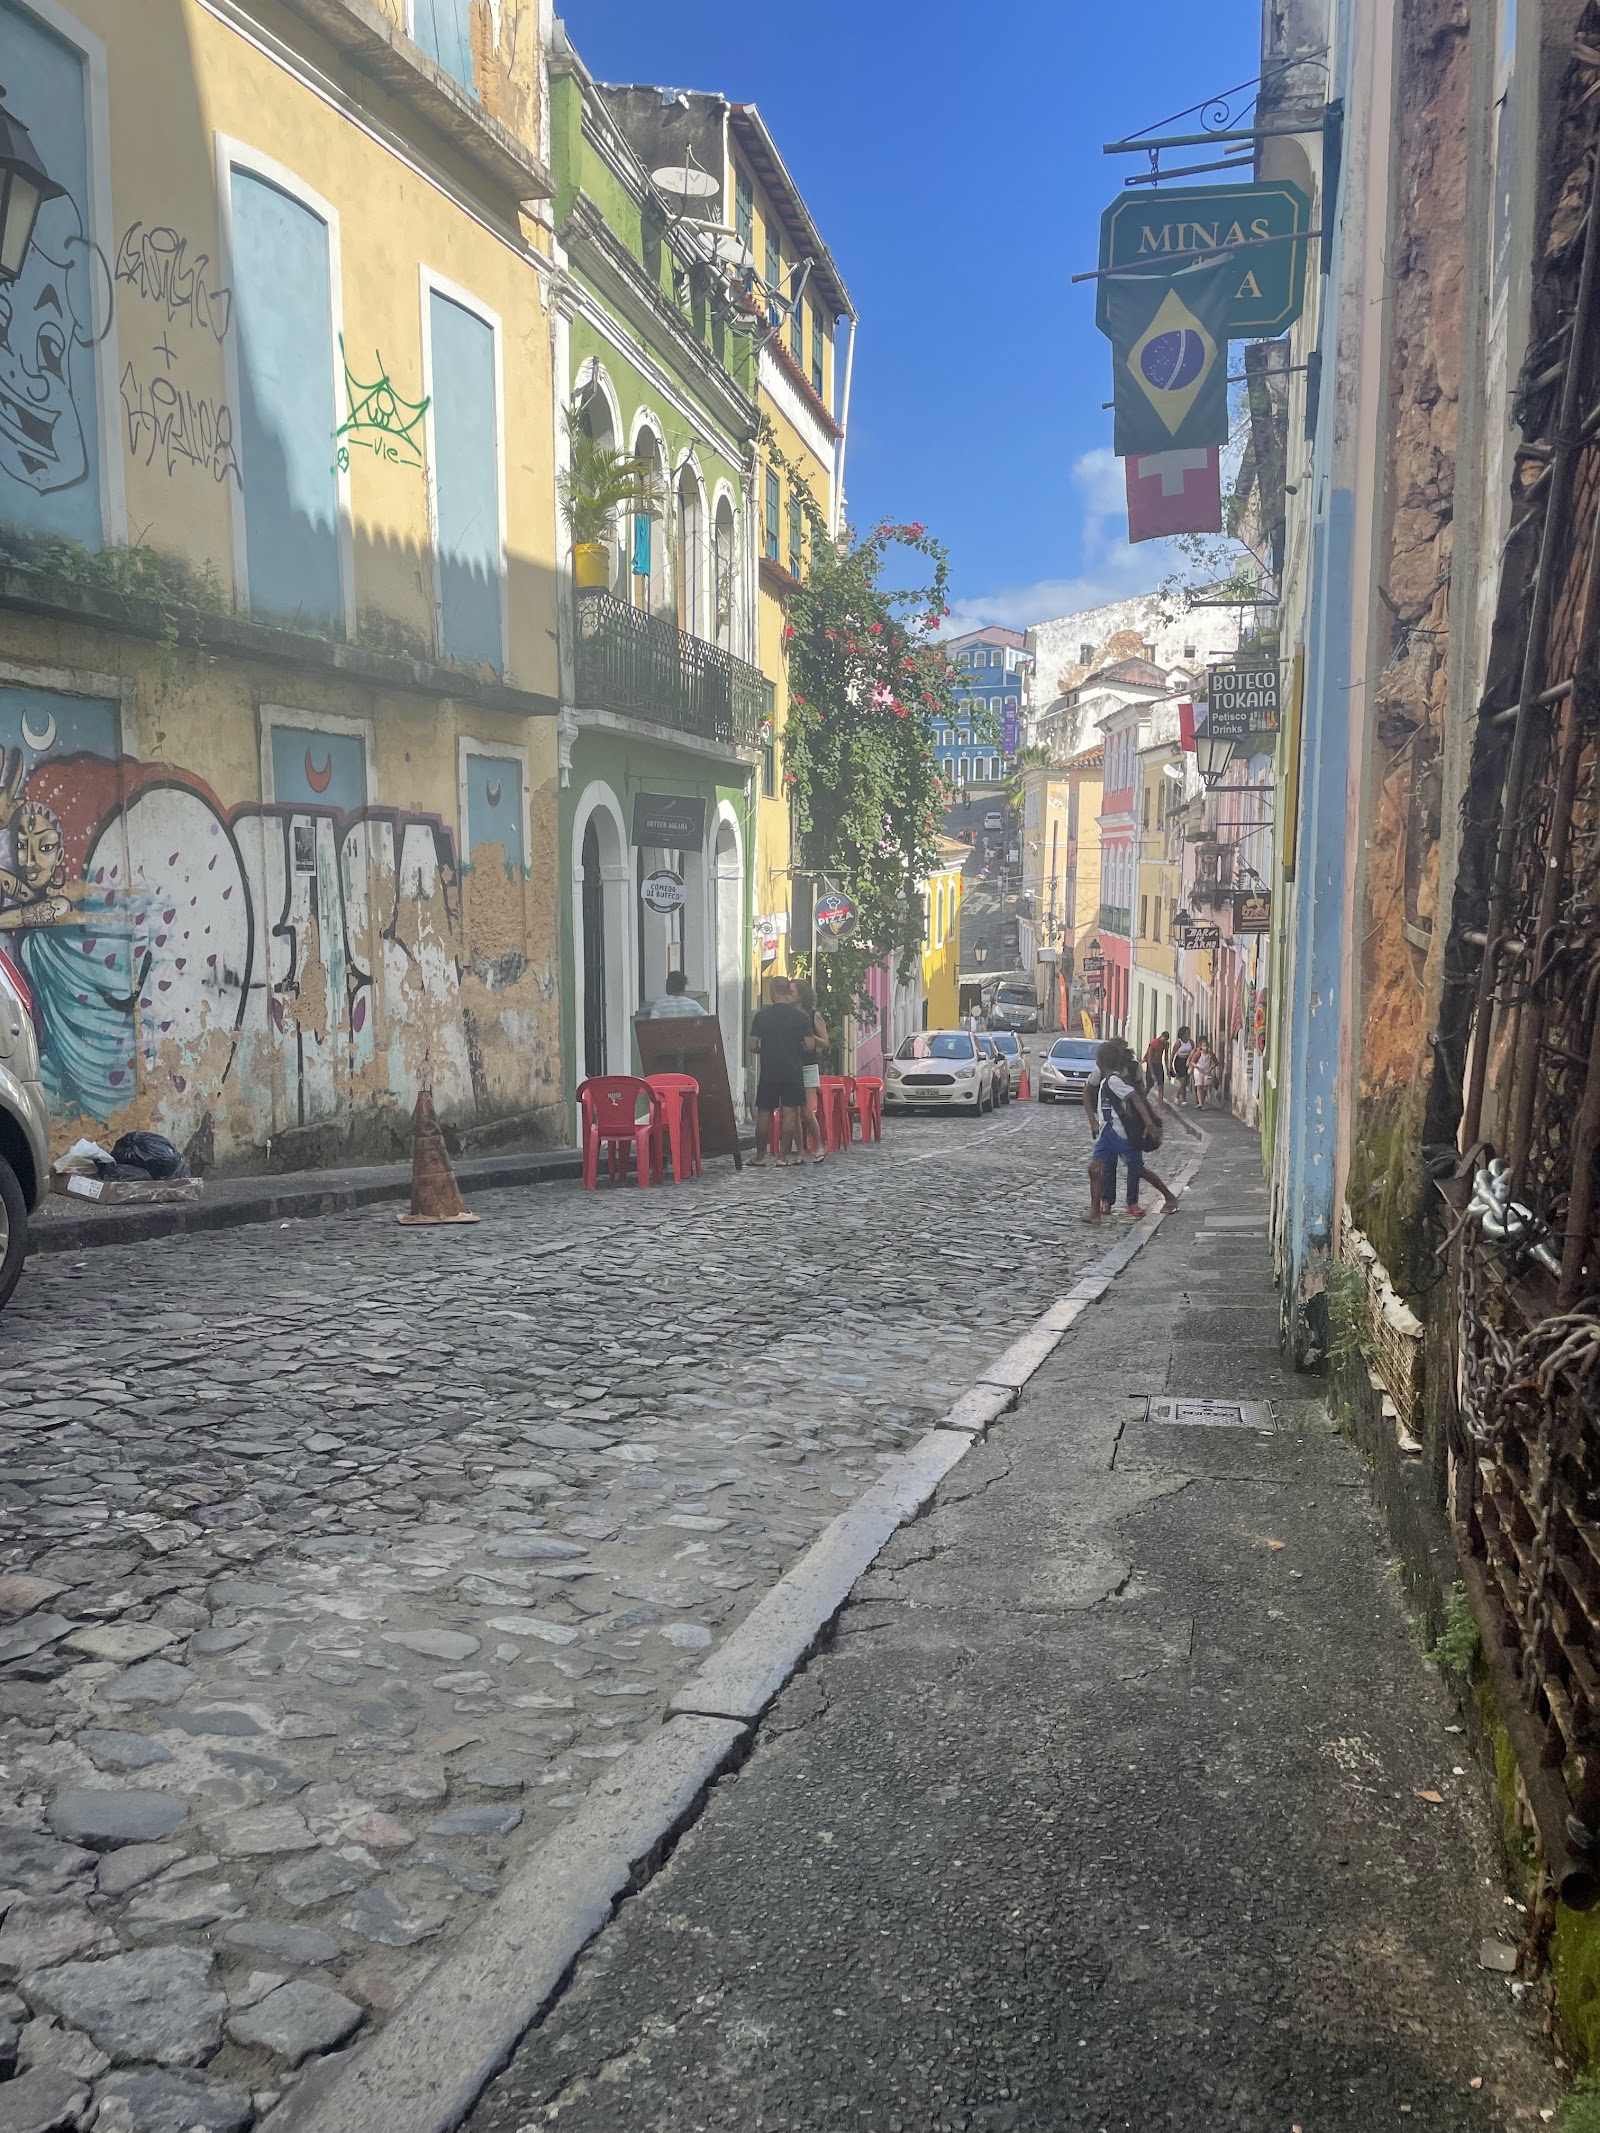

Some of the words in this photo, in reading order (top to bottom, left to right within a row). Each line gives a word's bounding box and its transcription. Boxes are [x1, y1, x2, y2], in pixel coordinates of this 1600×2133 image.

[1136, 218, 1270, 253] MINAS
[1213, 672, 1276, 691] BOTECO
[1212, 690, 1277, 710] TOKAIA
[1212, 712, 1247, 722] Petisco
[1212, 725, 1243, 735] Drinks
[646, 889, 654, 897] DI
[650, 883, 676, 893] COMIDA
[818, 911, 854, 926] PIZZA
[1187, 928, 1209, 937] BAR
[1186, 940, 1217, 949] CARMO
